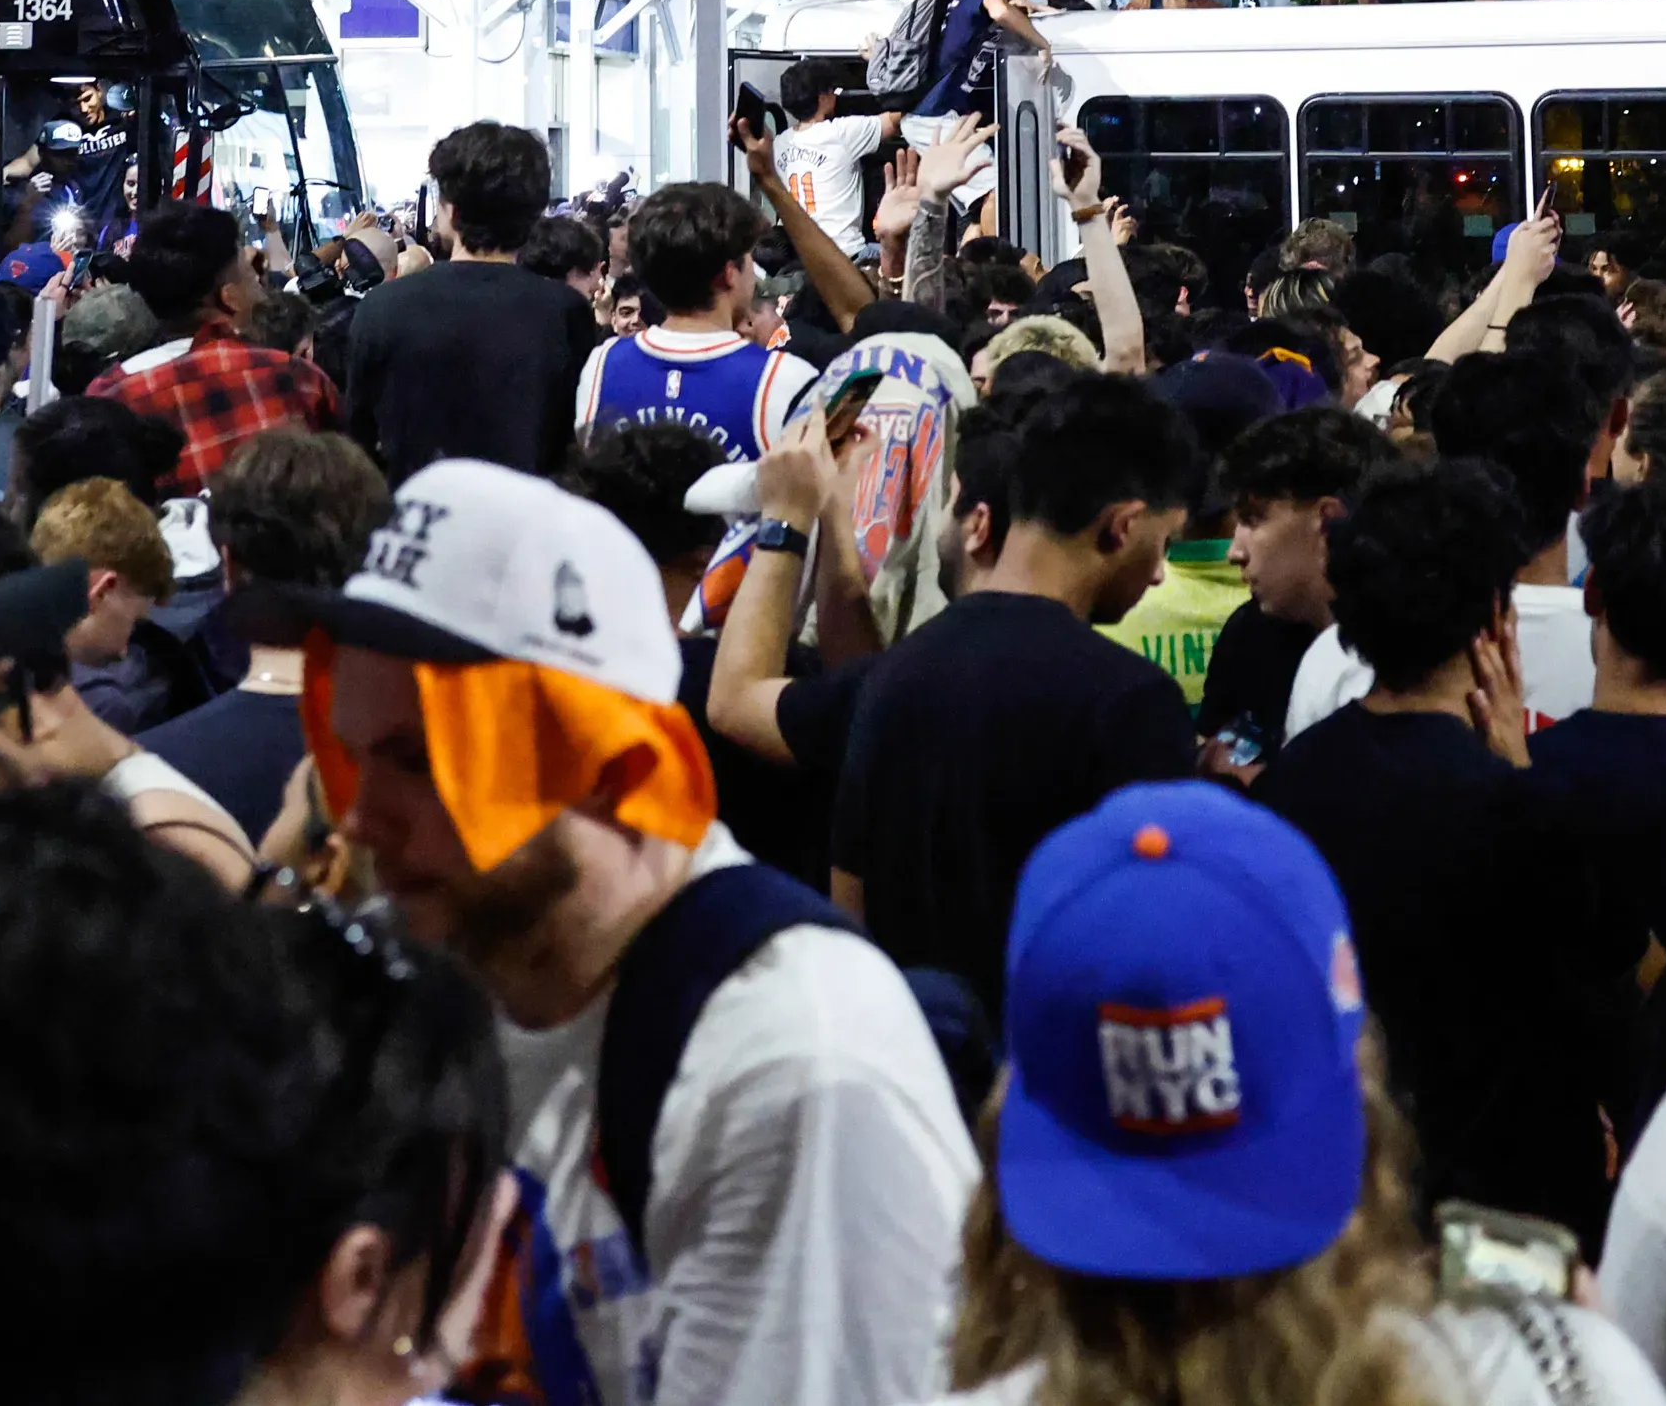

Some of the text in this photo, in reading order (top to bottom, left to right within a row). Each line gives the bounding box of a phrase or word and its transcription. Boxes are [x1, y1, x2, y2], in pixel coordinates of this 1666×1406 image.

[777, 147, 827, 172] BRUNSON
[789, 171, 816, 215] 11
[1098, 1016, 1232, 1076] RUN
[1109, 1072, 1242, 1124] NYC
